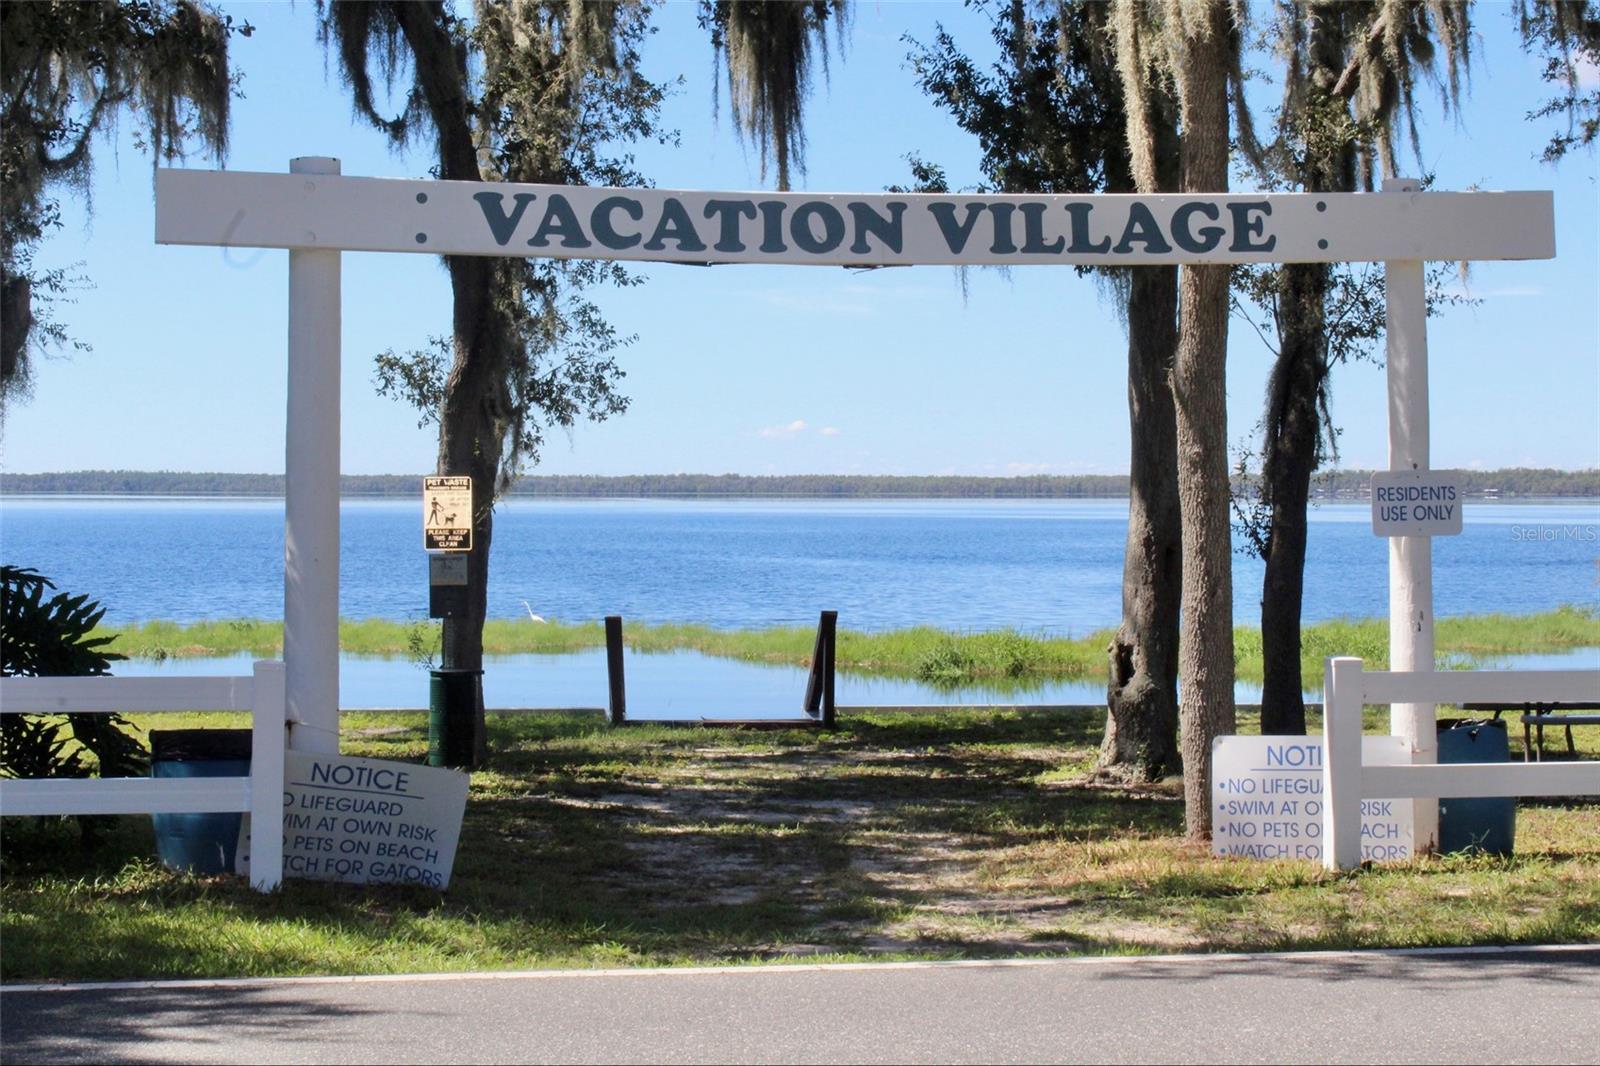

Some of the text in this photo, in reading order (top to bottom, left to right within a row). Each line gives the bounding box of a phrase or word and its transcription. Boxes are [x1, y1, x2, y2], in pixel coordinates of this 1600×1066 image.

[473, 191, 1277, 254] VACATION VILLAGE
[1377, 486, 1456, 501] RESIDENTS
[1380, 505, 1454, 521] USE ONLY
[1267, 745, 1322, 766] NOTI
[311, 762, 409, 792] NOTICE
[1228, 779, 1323, 794] NO LIFEGU
[283, 792, 404, 817] O LIFEGUARD
[1228, 801, 1274, 815] SWIM
[1280, 801, 1299, 816] AT
[283, 813, 438, 843] IM AT OWN RISK
[1229, 822, 1398, 839] NO PETS O ACH
[293, 835, 333, 852] PETS
[339, 838, 370, 855] ON
[376, 842, 439, 865] BEACH
[1228, 844, 1408, 860] WATCH FO TORS
[283, 854, 442, 889] TCH FOR GATORS
